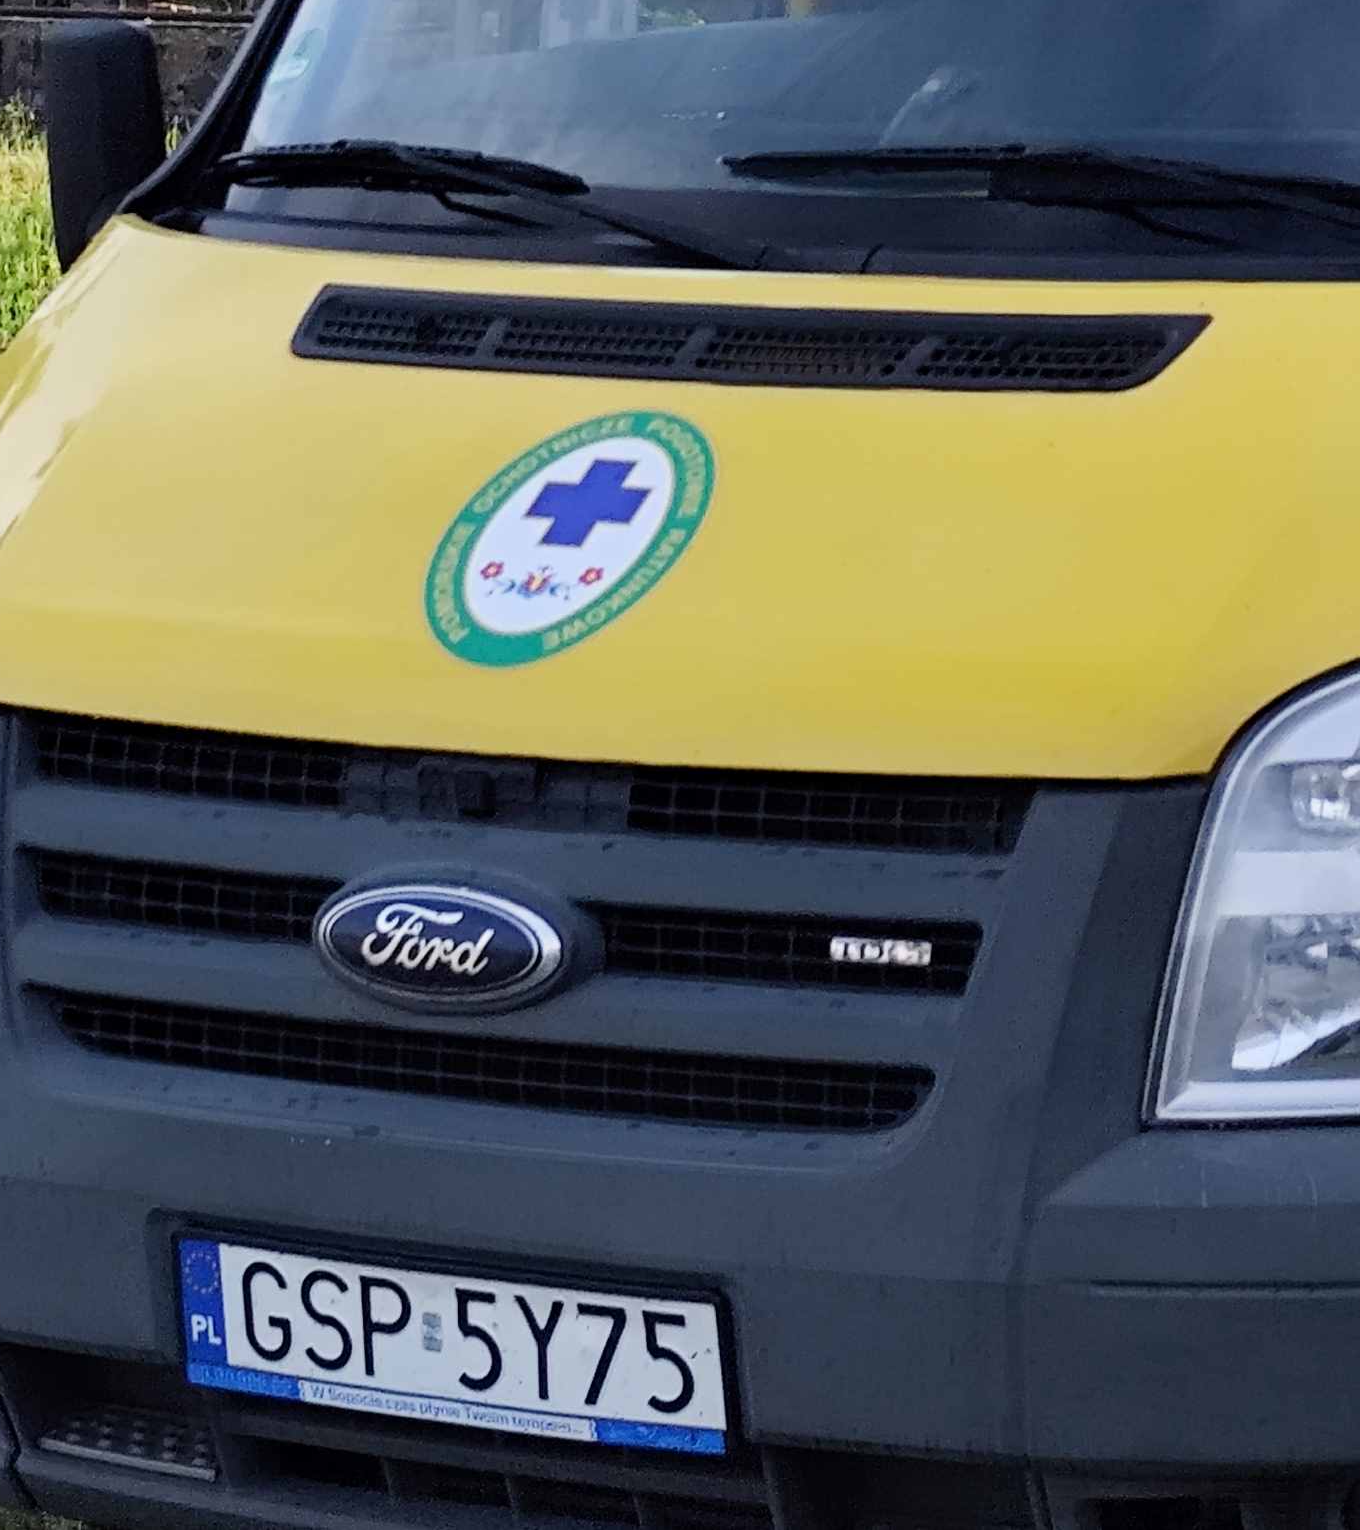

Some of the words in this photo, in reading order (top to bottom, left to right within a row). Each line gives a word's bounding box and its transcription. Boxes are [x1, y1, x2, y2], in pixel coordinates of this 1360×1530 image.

[360, 901, 496, 977] Ford
[191, 1314, 222, 1345] PL
[241, 1261, 412, 1376] GSP
[455, 1287, 696, 1414] 5Y75
